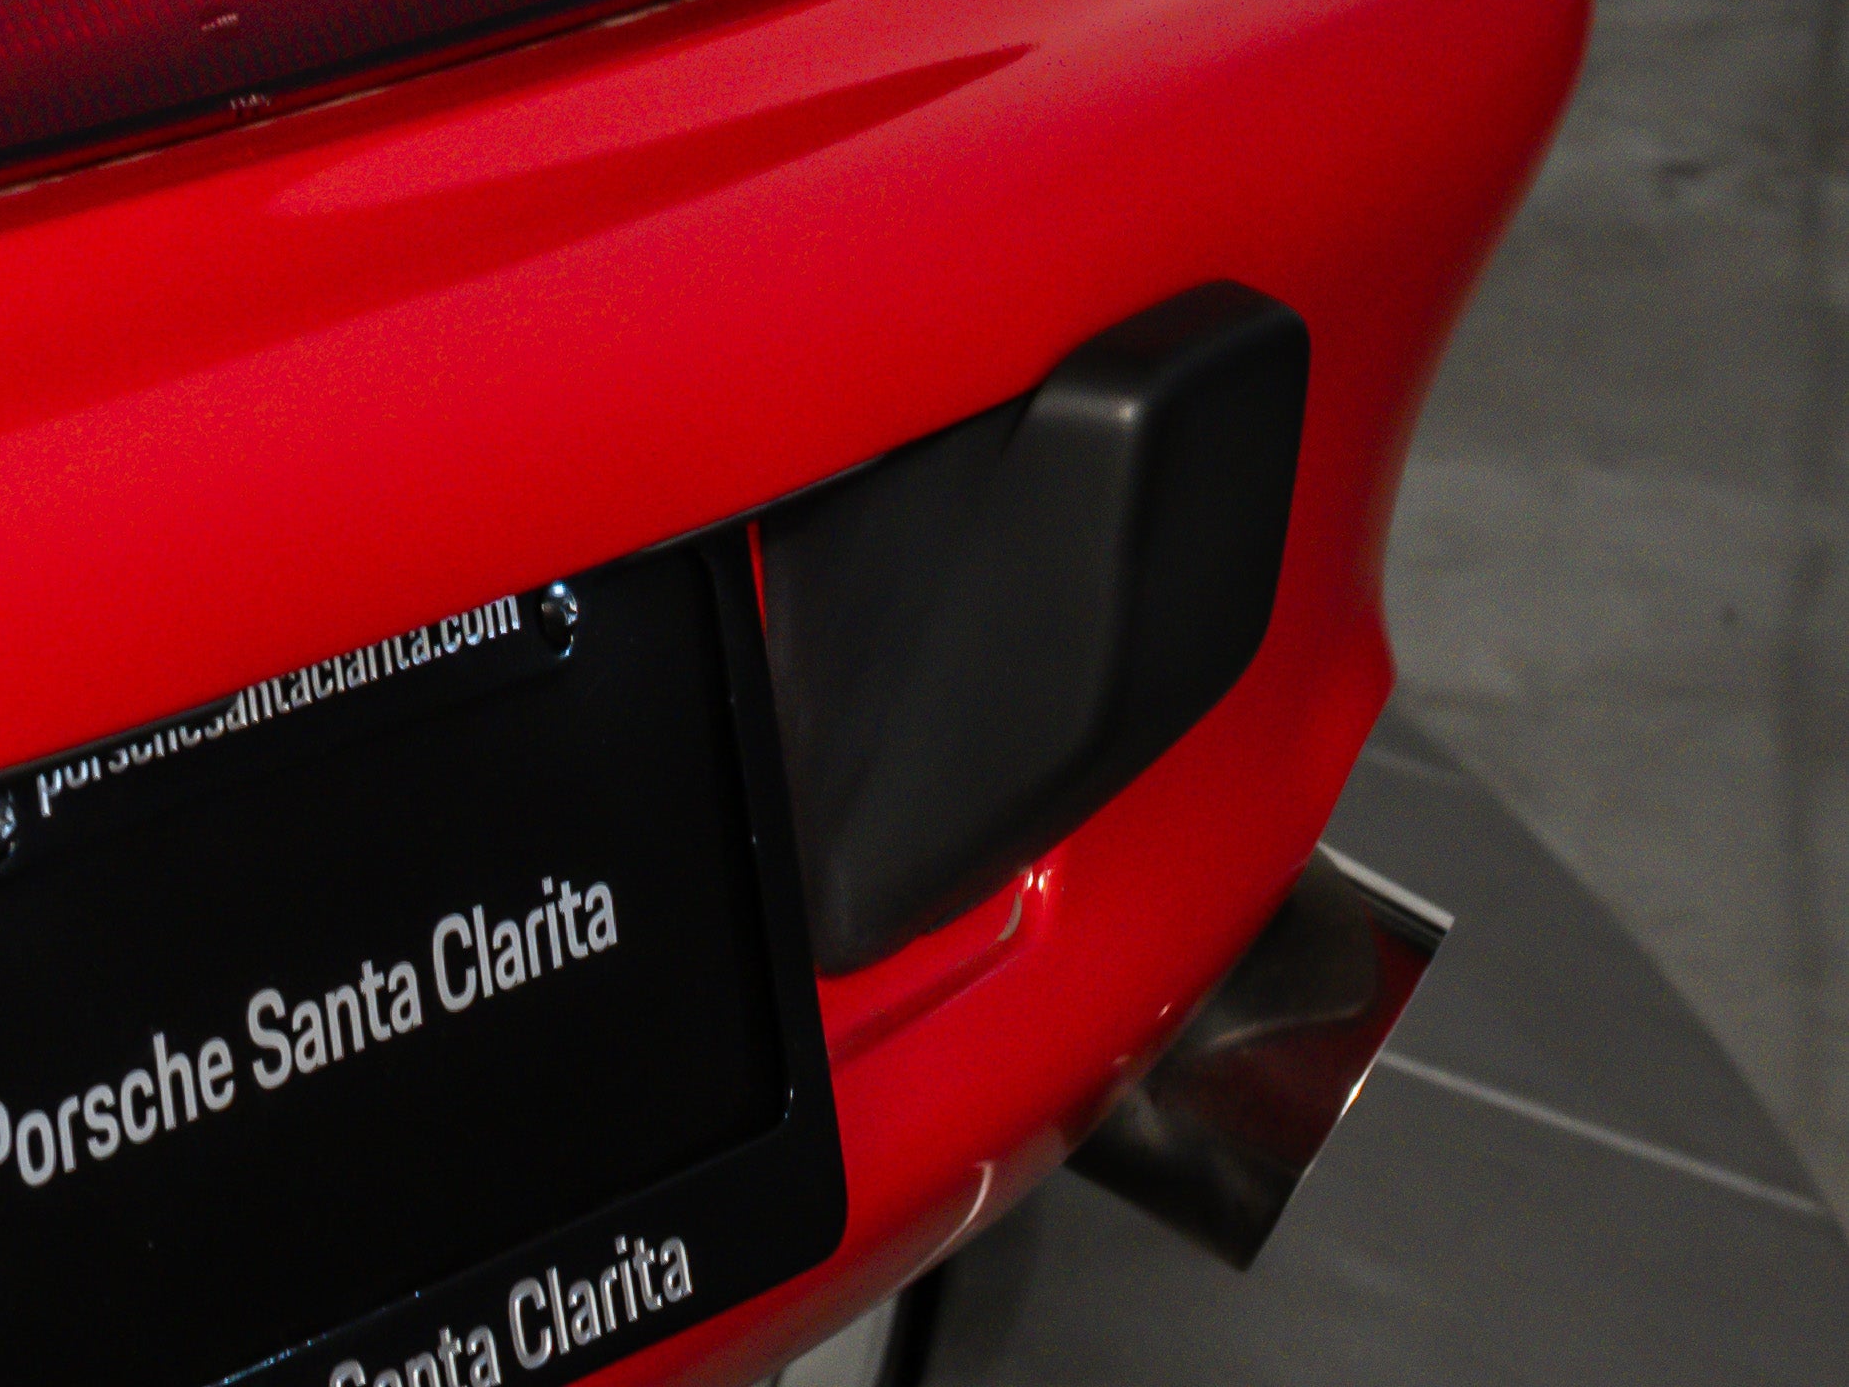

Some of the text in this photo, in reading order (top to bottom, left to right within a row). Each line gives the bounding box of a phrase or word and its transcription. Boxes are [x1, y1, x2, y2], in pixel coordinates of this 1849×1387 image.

[245, 959, 424, 1090] Santa
[431, 876, 619, 1014] Clarita
[329, 1234, 694, 1387] nta Clarita
